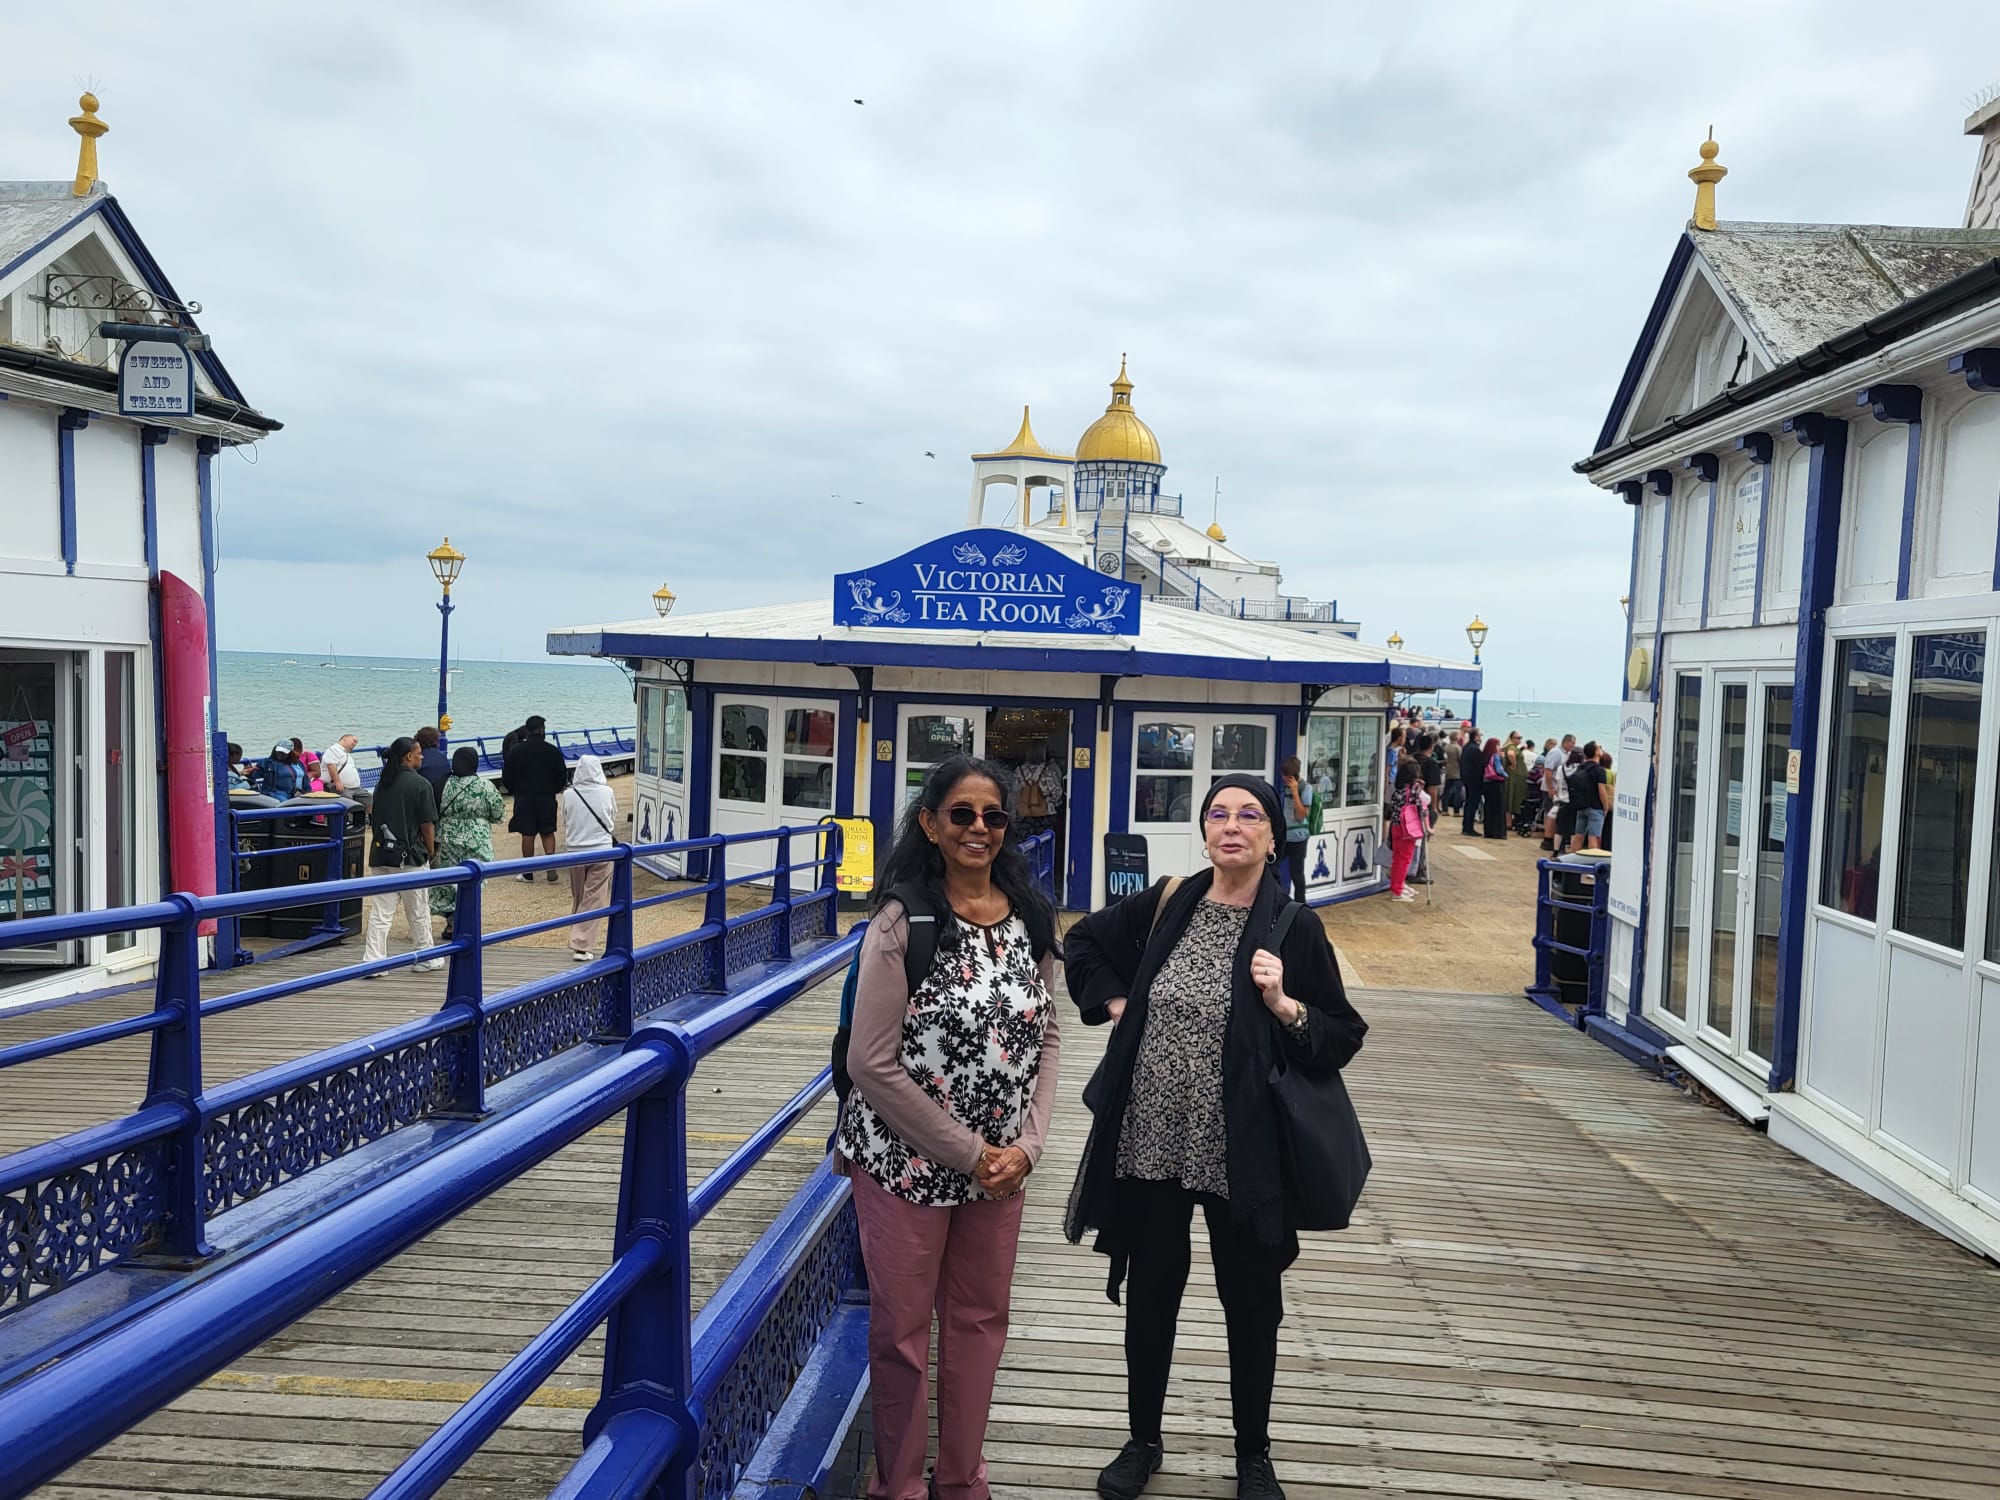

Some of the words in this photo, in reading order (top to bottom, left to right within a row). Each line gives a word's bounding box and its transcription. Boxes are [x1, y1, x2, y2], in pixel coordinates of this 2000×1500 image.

[129, 355, 182, 369] SWEETS
[142, 375, 170, 389] AND
[129, 396, 182, 409] TREATS
[912, 563, 1066, 593] VICTORIAN
[915, 595, 968, 621] TEA
[977, 596, 1062, 624] ROOM
[11, 728, 32, 743] OPEN
[931, 734, 952, 742] OPEN
[1110, 871, 1144, 897] OPEN
